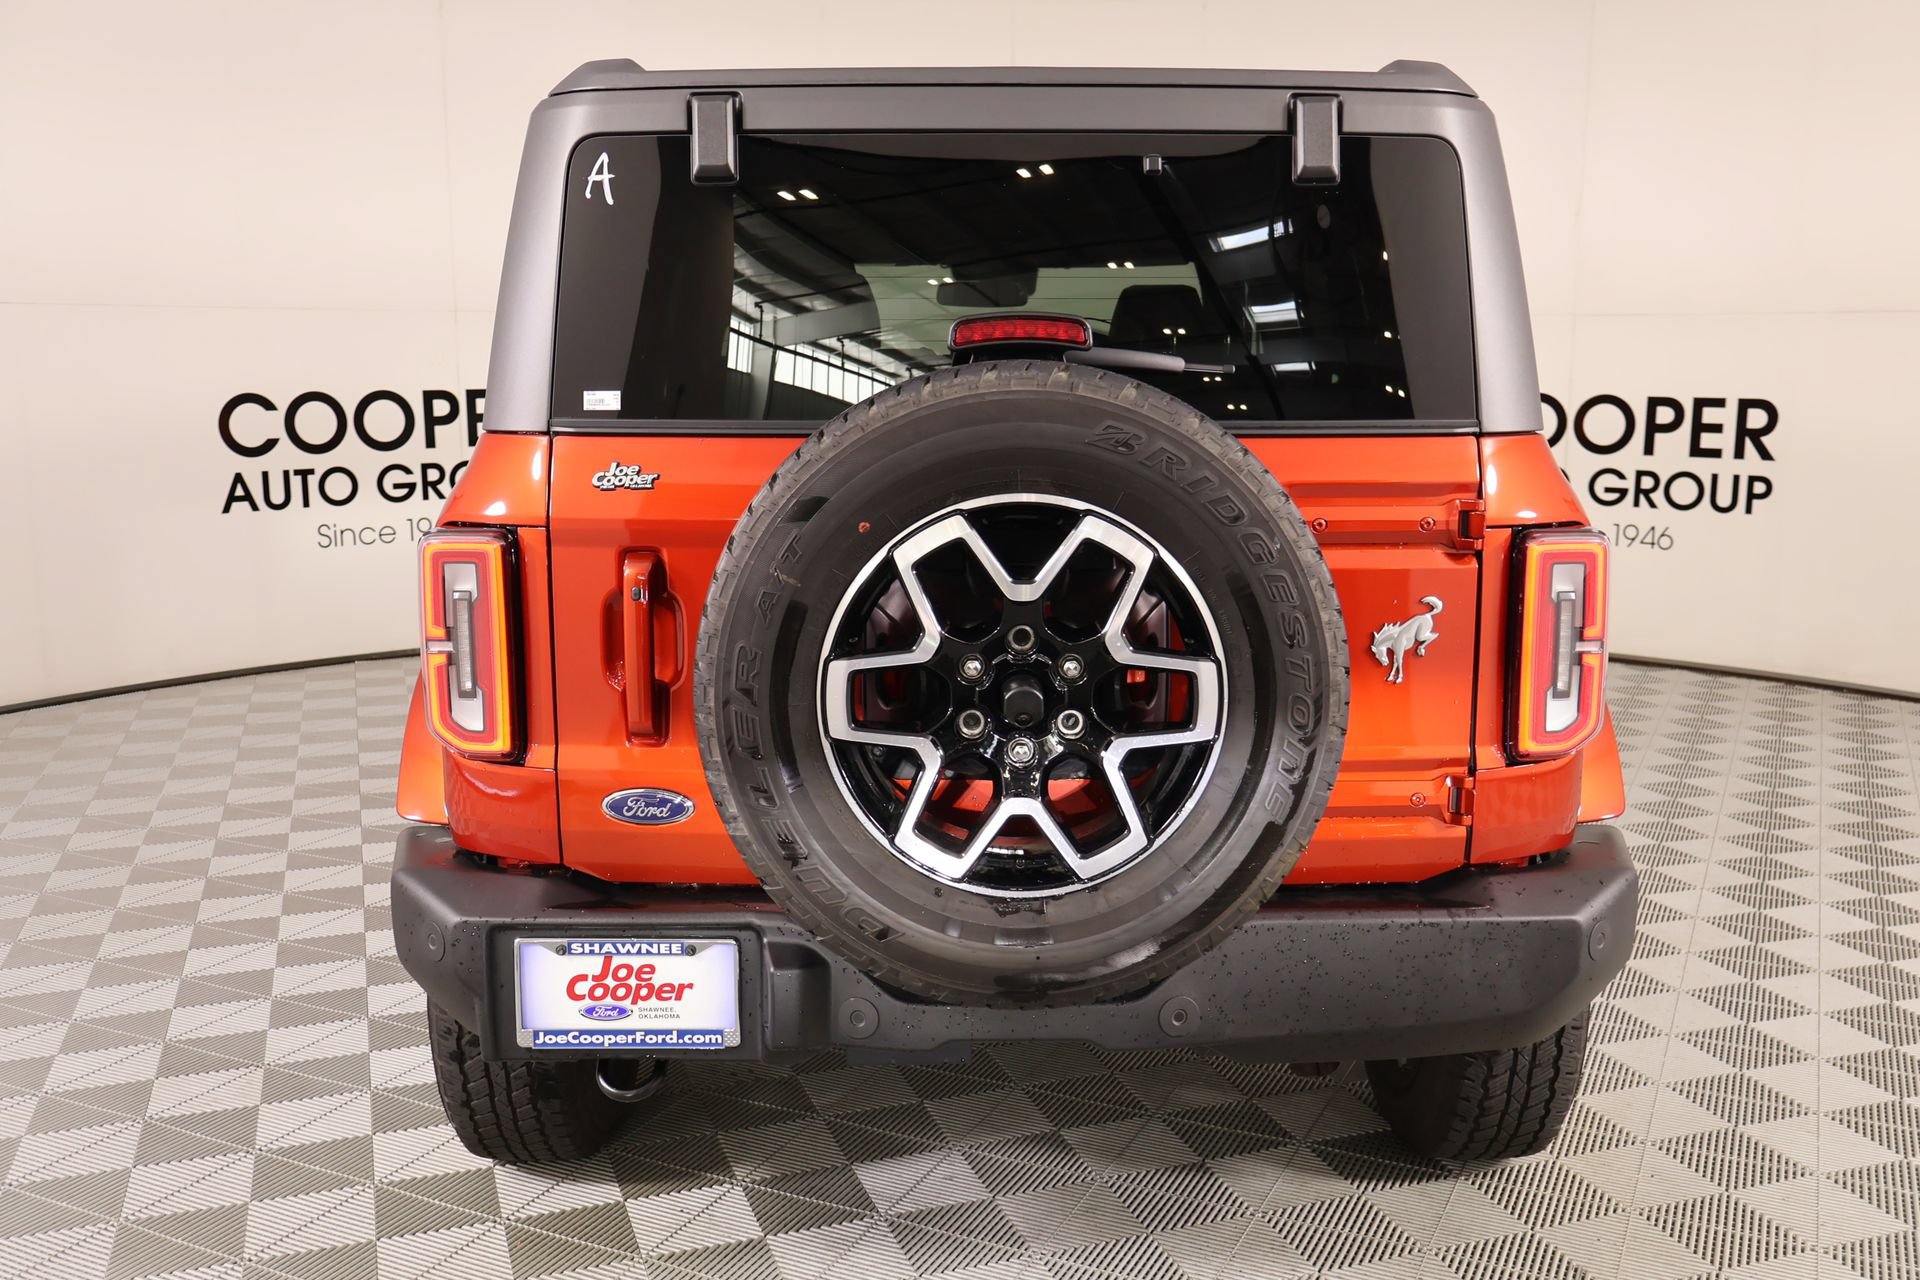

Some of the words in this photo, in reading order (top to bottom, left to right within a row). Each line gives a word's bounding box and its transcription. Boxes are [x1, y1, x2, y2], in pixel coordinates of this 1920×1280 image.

[585, 152, 616, 206] A
[218, 389, 487, 458] COOPE
[592, 472, 658, 488] Cooper
[605, 461, 640, 476] Joe
[222, 466, 359, 514] AUTO
[1588, 468, 1773, 514] GROUP
[317, 523, 397, 549] Since
[1613, 523, 1674, 550] 1946
[1087, 425, 1321, 825] BRIDGESTONE
[623, 796, 672, 817] Ford
[730, 641, 905, 945] DUELER
[570, 943, 682, 954] SHAWNEE
[592, 956, 656, 983] Joe
[566, 974, 693, 1005] Cooper
[535, 1031, 722, 1047] JoeCooperFord.com
